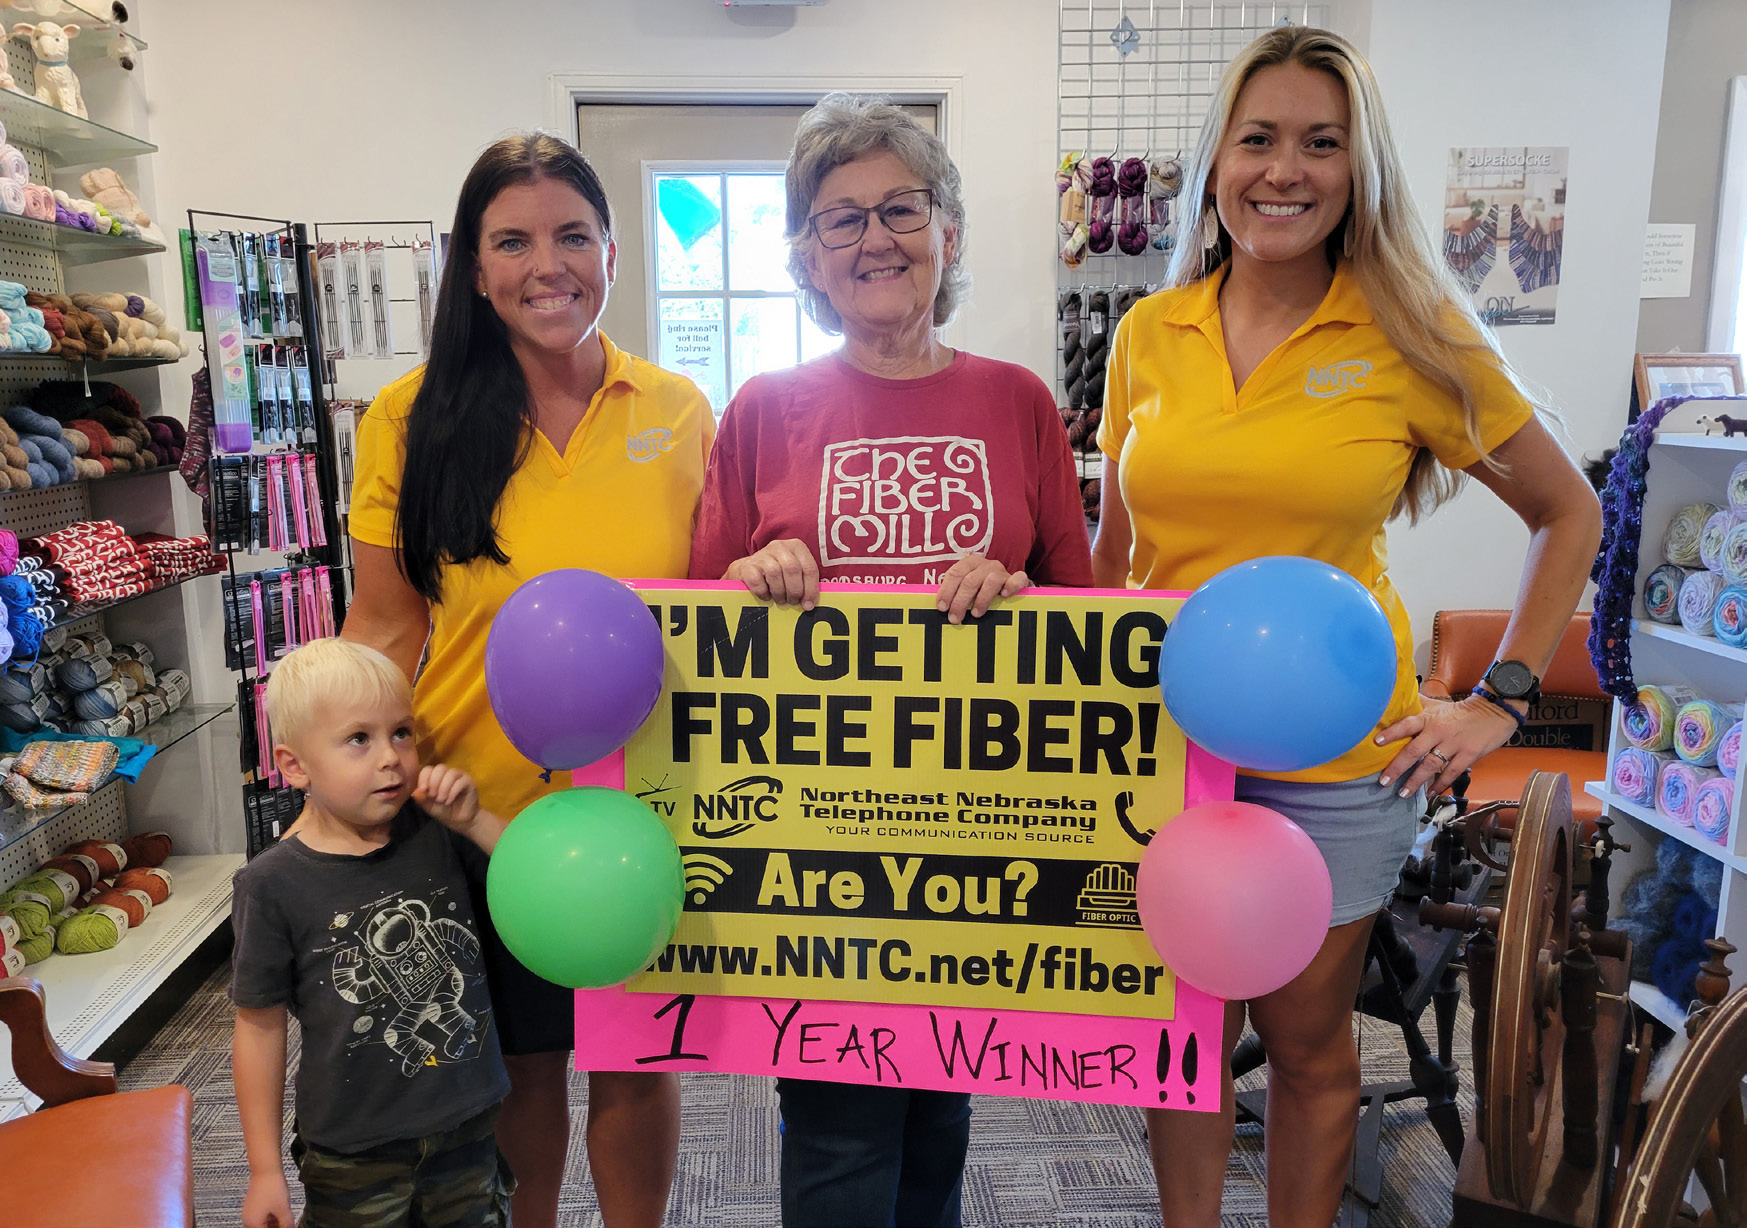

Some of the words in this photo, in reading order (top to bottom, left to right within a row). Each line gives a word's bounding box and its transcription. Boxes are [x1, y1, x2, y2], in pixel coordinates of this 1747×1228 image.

[1467, 153, 1551, 168] SUPERSOCKE
[1307, 366, 1368, 388] NNTC
[626, 435, 673, 452] NNTC
[831, 477, 983, 515] FIBER
[831, 512, 945, 554] MILL
[793, 605, 1164, 690] GETTING
[670, 692, 872, 768] FREE
[893, 696, 1159, 777] FIBER!
[1507, 727, 1571, 747] Double
[650, 801, 676, 817] TV
[693, 793, 779, 822] NNTC
[799, 787, 948, 808] Northeast
[956, 791, 1098, 812] Nebraska
[799, 803, 947, 824] Telephone
[956, 808, 1097, 831] Company
[825, 824, 873, 837] YOUR
[877, 826, 1018, 842] COMMUNICATION
[1024, 832, 1096, 844] SOURCE
[756, 852, 866, 909] Are
[878, 855, 1040, 916] You?
[1082, 911, 1107, 921] FIBER
[1109, 913, 1137, 923] OPTIC
[635, 993, 710, 1065] 1
[760, 999, 904, 1083] YEAR
